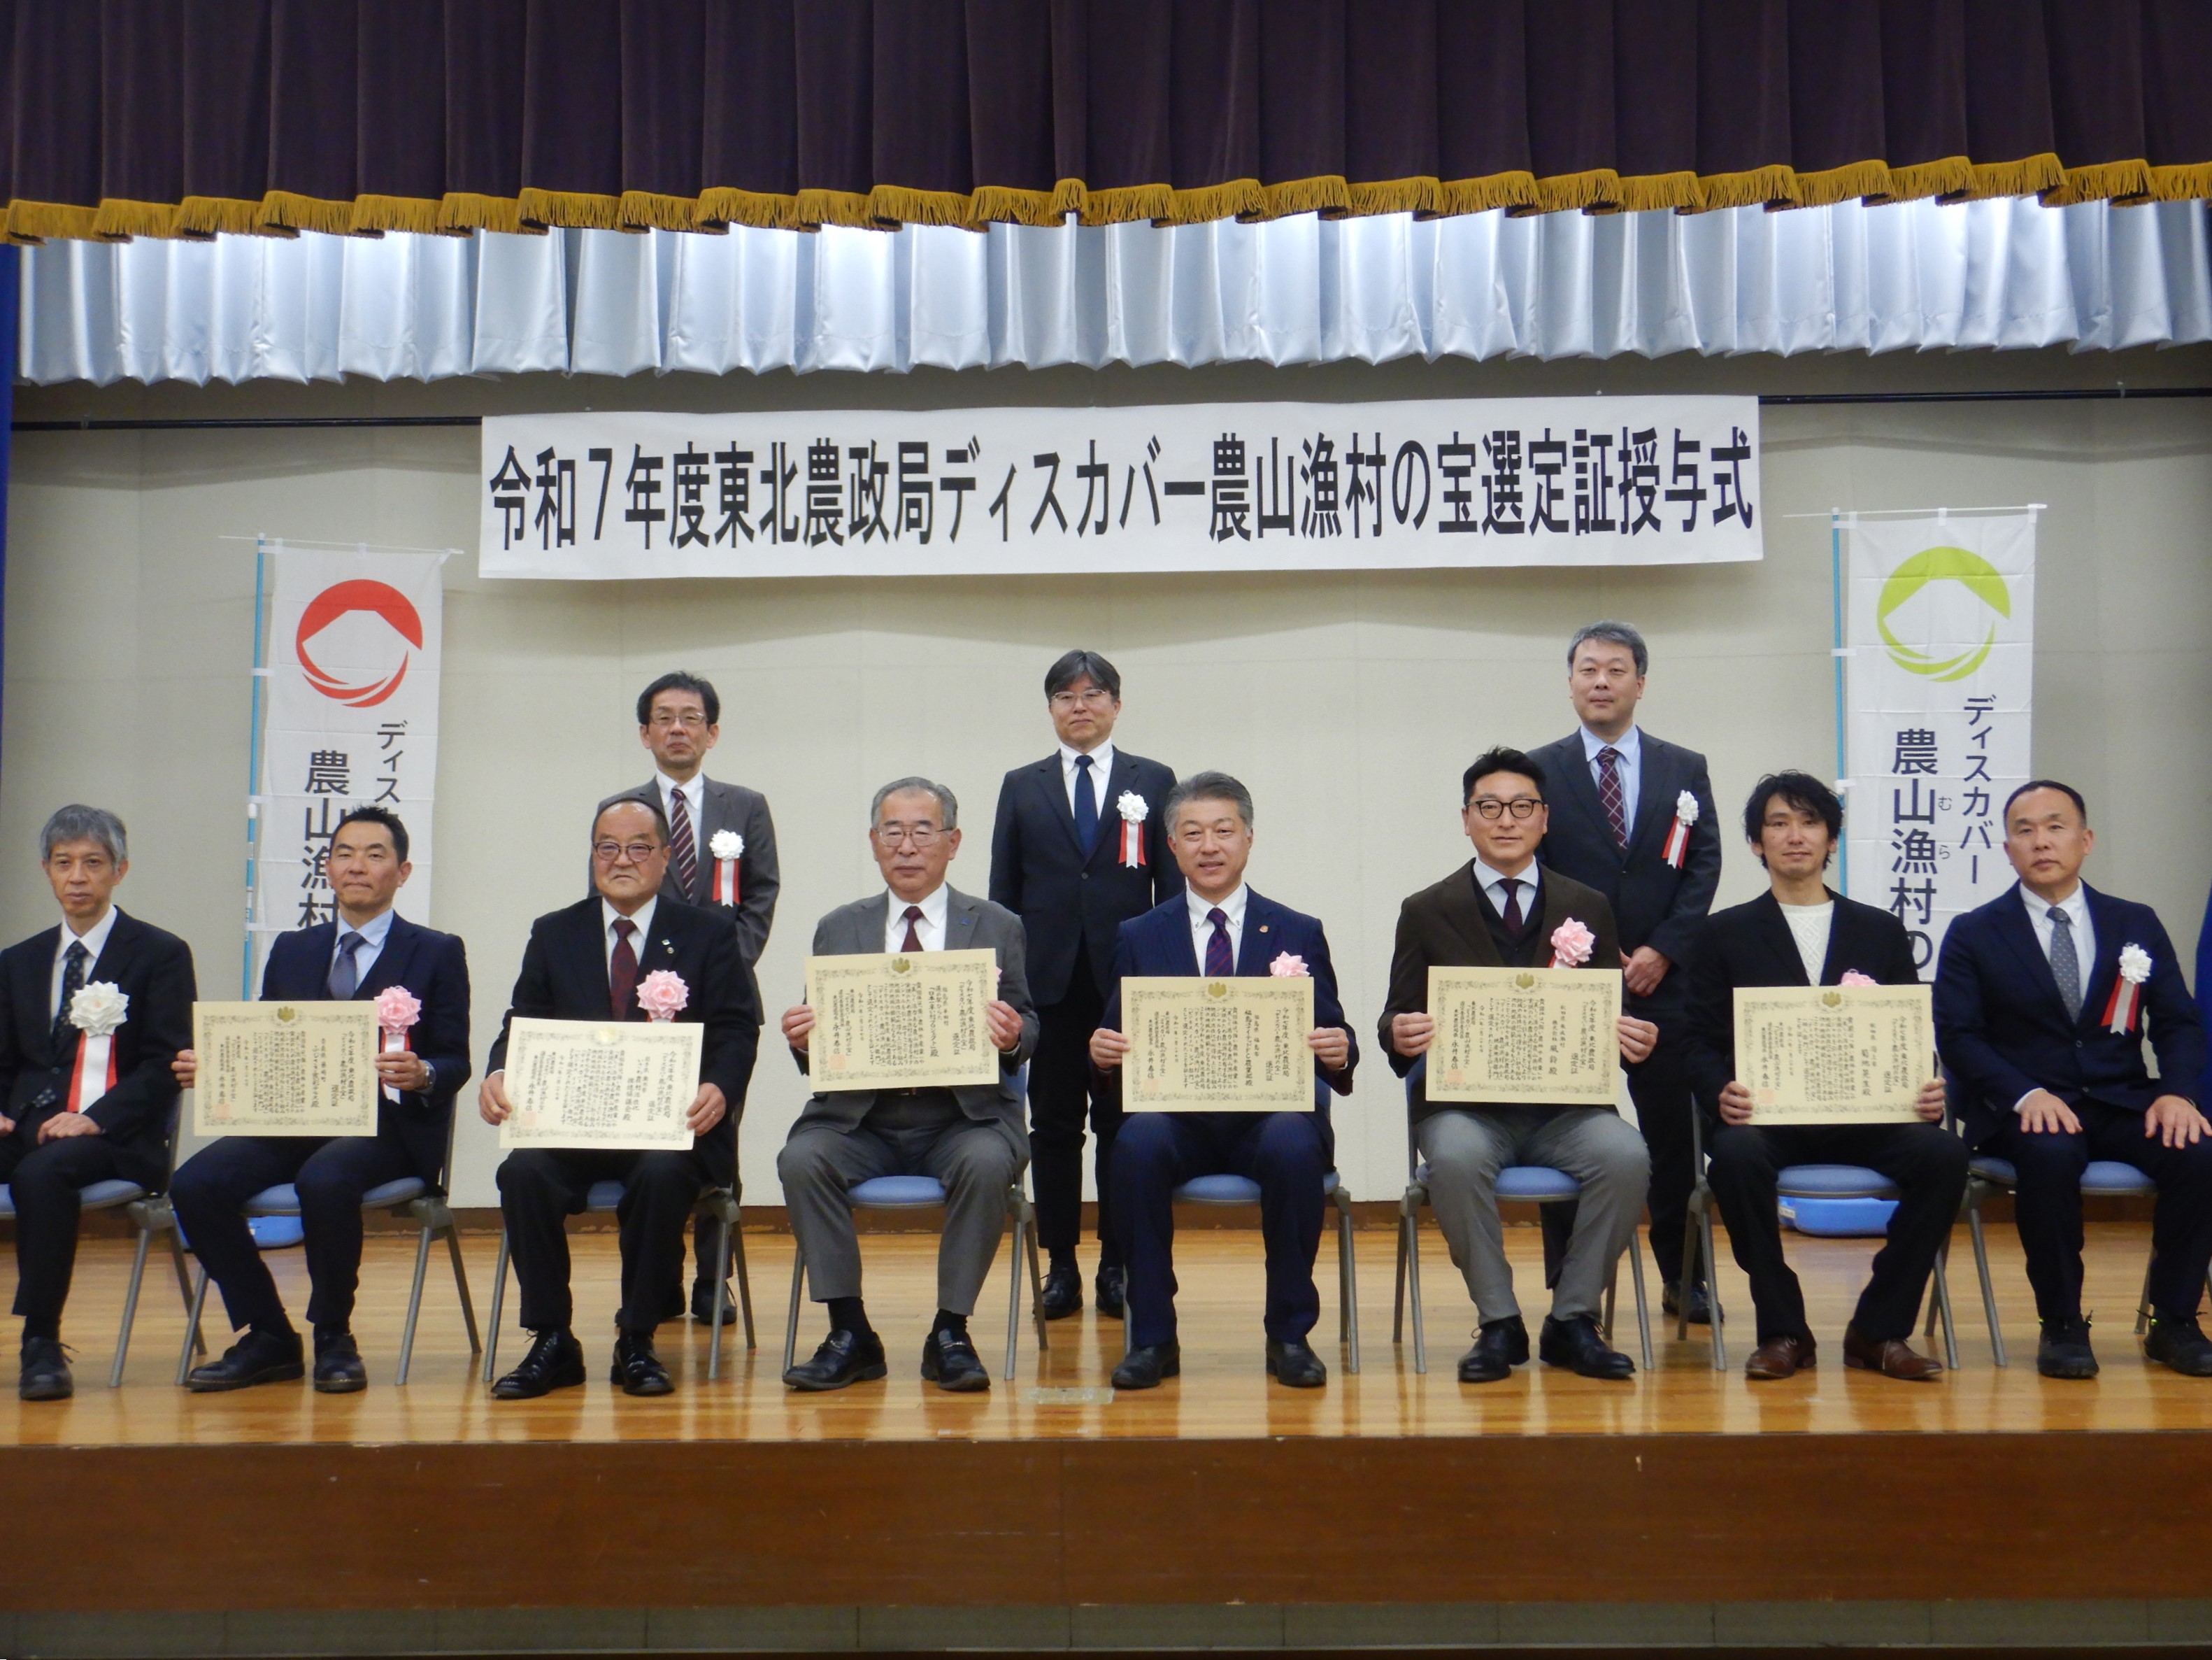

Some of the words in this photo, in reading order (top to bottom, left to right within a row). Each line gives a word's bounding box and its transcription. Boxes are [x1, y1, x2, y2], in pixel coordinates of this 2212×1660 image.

[490, 426, 1753, 551] 令和7年度東北農政局ディスカバー農山漁村の宝選定証授与式
[374, 720, 408, 818] ディス
[1960, 694, 1997, 884] ディスカバー
